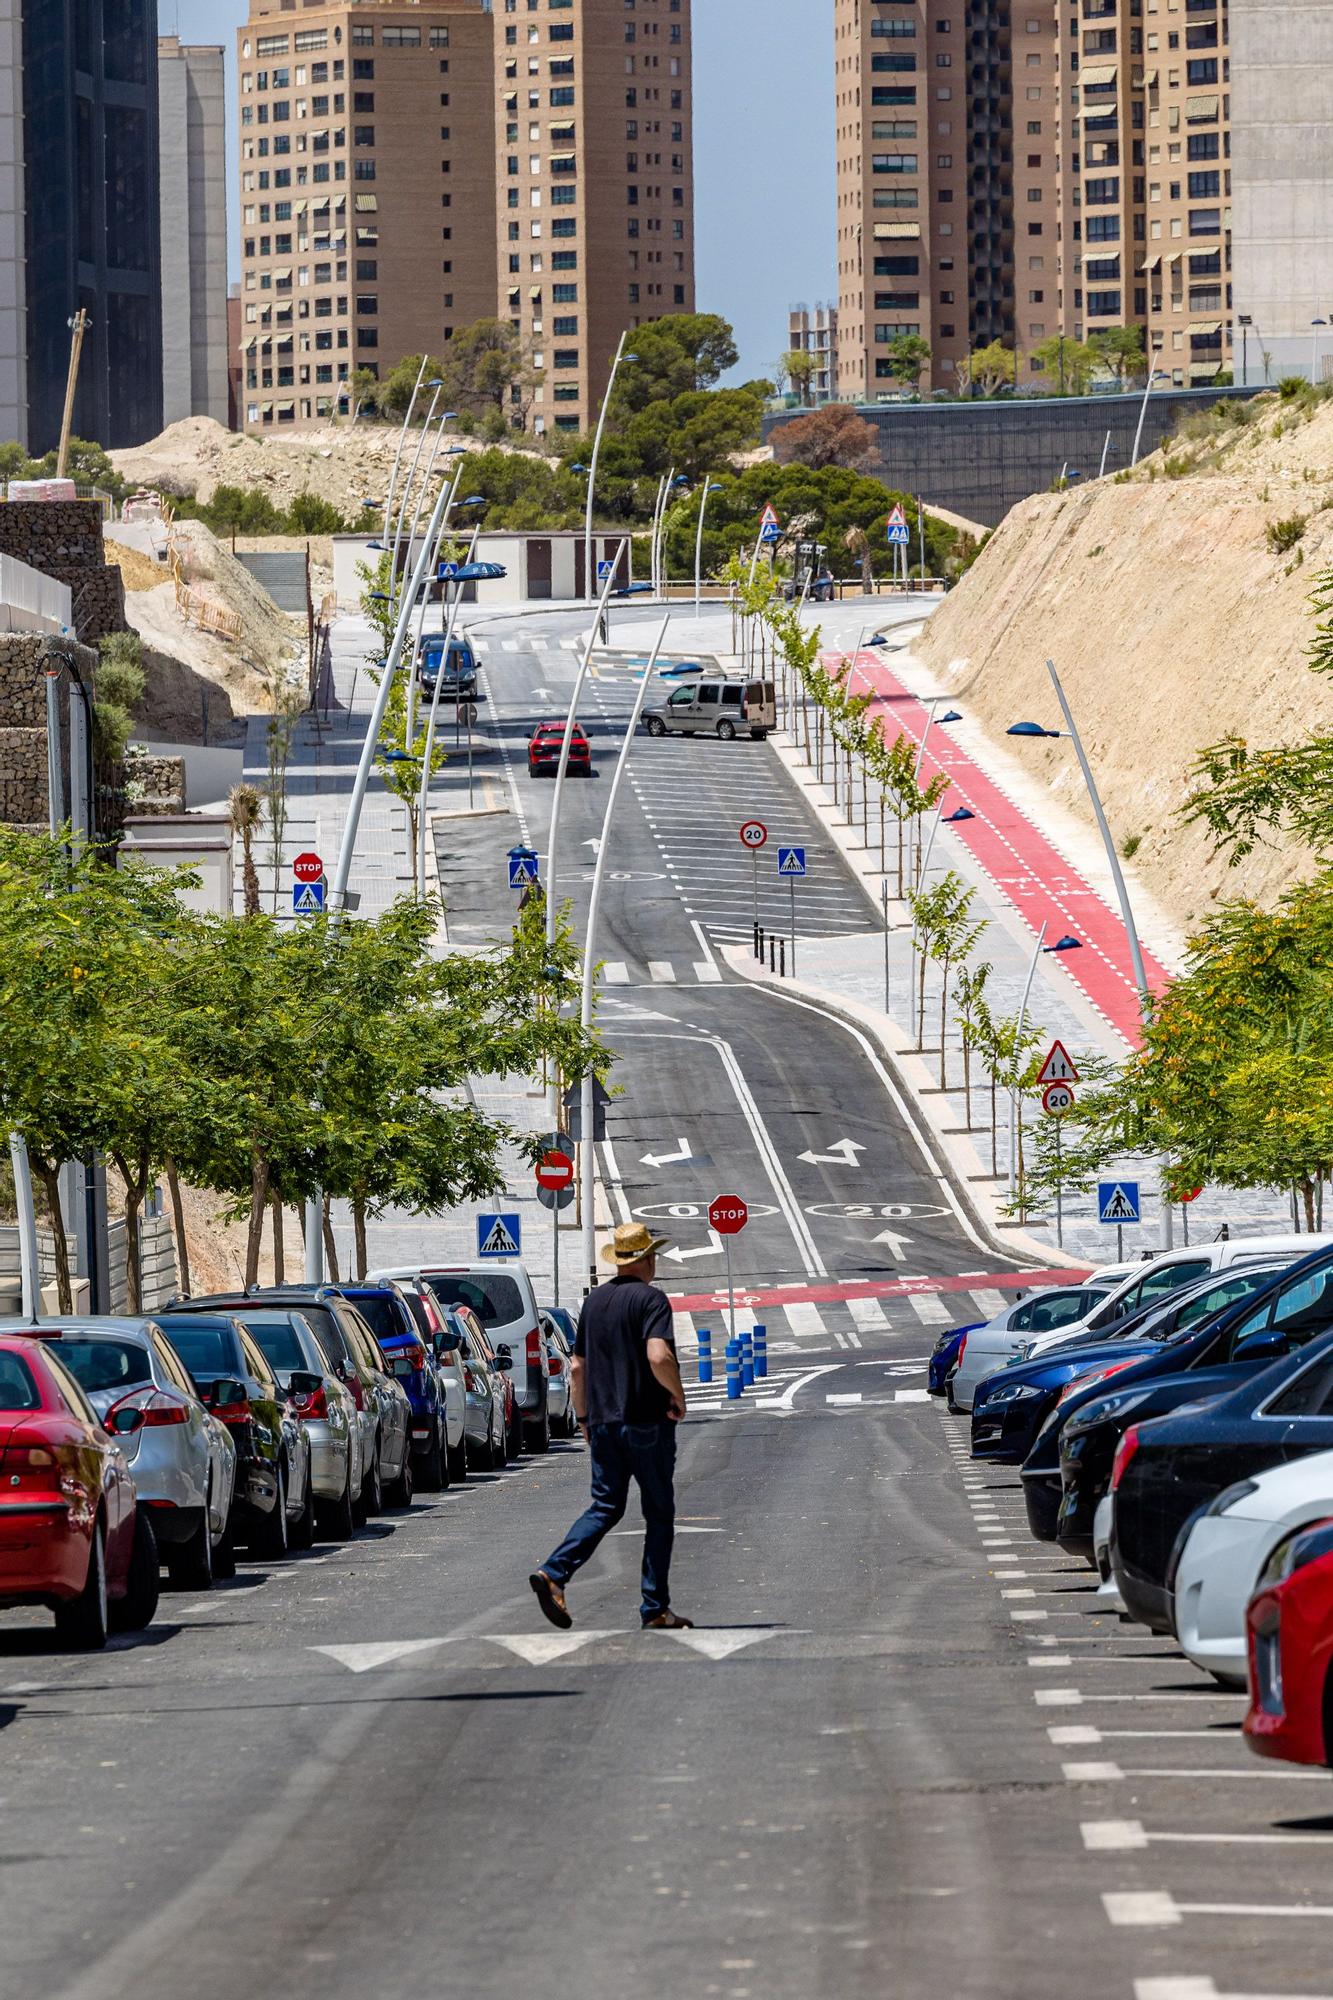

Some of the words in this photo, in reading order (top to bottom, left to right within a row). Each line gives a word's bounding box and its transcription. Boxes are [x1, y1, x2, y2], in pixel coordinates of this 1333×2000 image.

[746, 830, 762, 840] 20
[295, 863, 321, 872] STOP
[1050, 1095, 1069, 1107] 20
[712, 1209, 745, 1221] STOP
[843, 1205, 912, 1218] 20
